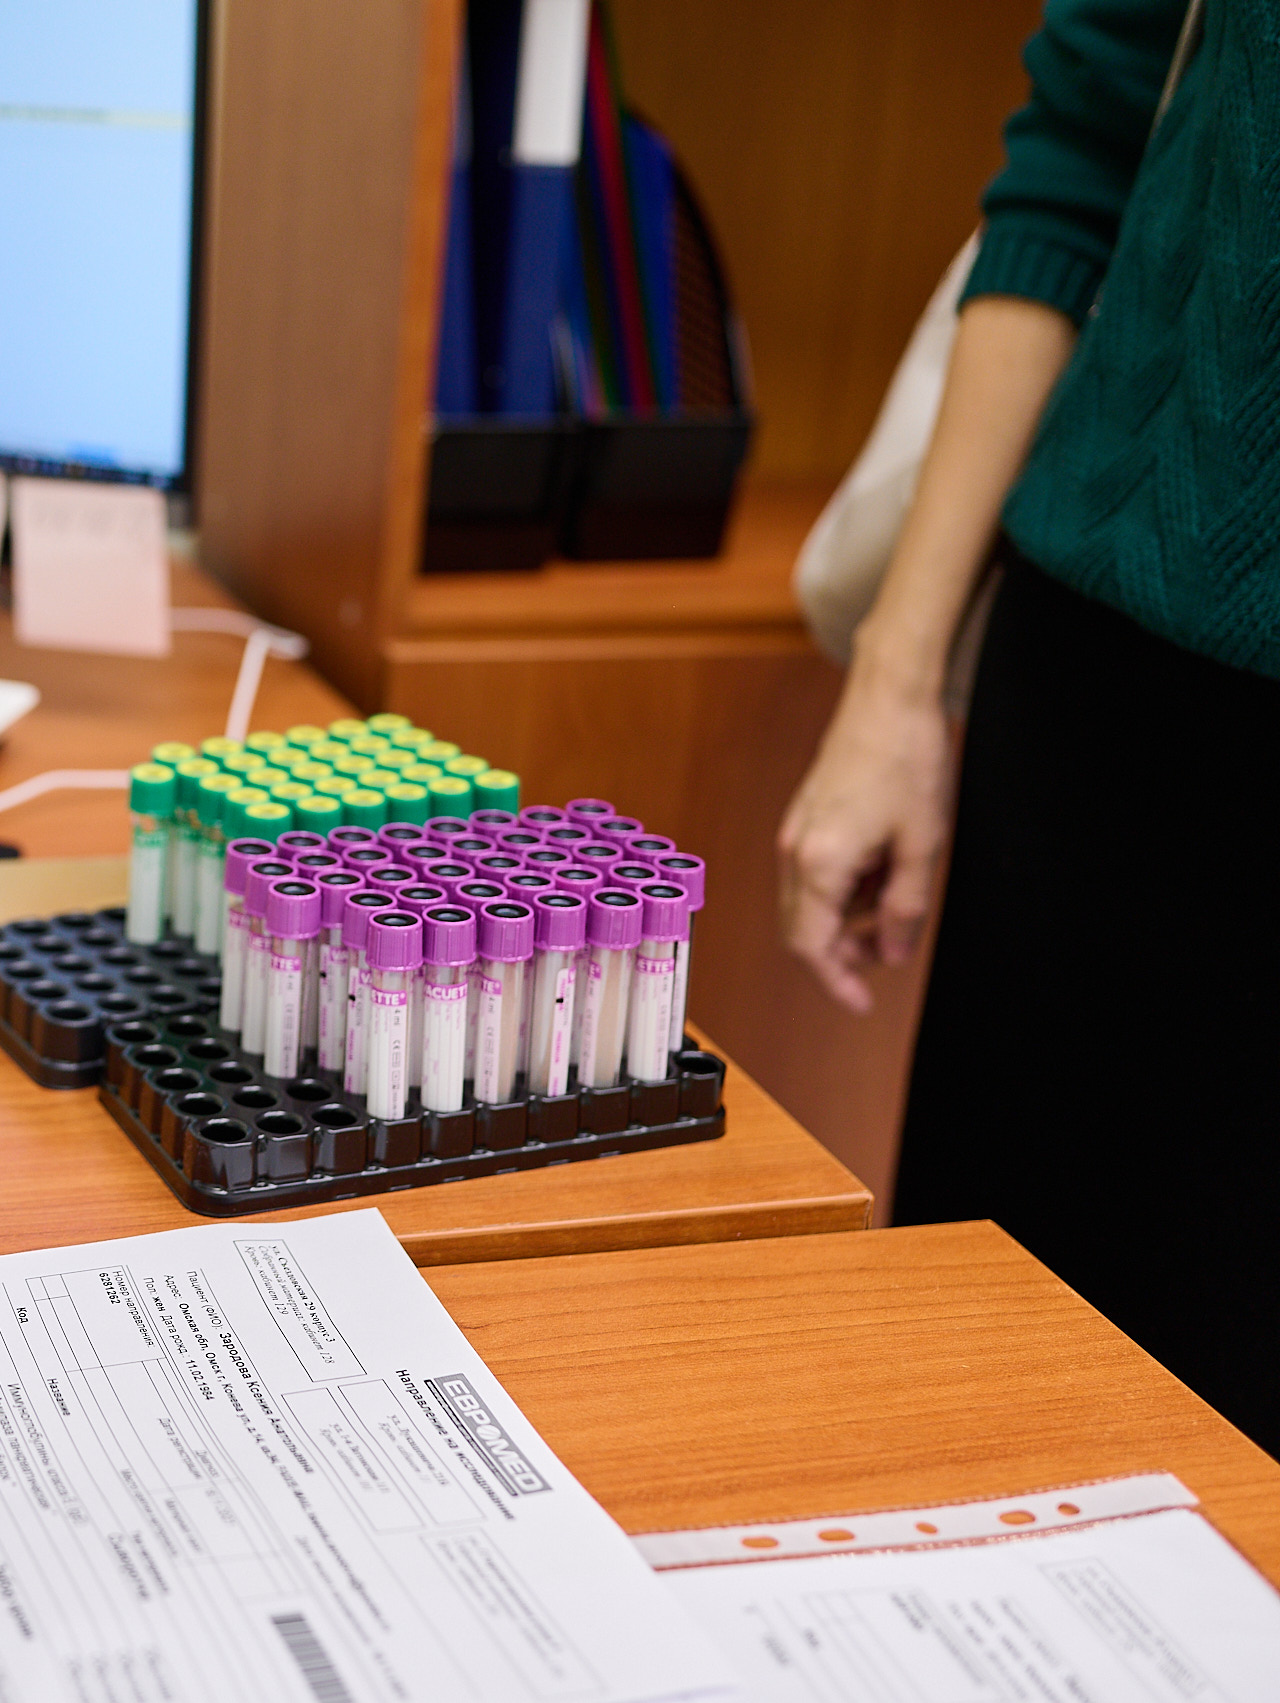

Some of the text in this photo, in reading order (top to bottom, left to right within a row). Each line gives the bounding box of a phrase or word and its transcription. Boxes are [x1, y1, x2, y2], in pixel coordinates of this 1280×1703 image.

[98, 1272, 121, 1304] 6281262
[112, 1270, 154, 1346] Номер направления:
[258, 1270, 279, 1301] кабинет
[274, 1303, 289, 1315] 129
[303, 1301, 316, 1311] 29
[16, 1307, 29, 1324] Код
[309, 1312, 330, 1337] корпус
[152, 1296, 166, 1312] жен
[159, 1315, 177, 1333] Дата
[185, 1359, 214, 1400] 11.02.1984
[163, 1274, 182, 1298] Адрес:
[178, 1303, 200, 1333] Омская
[205, 1352, 222, 1374] Омск
[221, 1383, 244, 1412] Конева
[186, 1270, 209, 1303] Пациент
[219, 1332, 252, 1379] Зародова
[246, 1380, 273, 1415] Ксения
[319, 1352, 335, 1364] 128
[46, 1378, 71, 1416] Название
[395, 1369, 448, 1435] Направление
[446, 1438, 459, 1449] на
